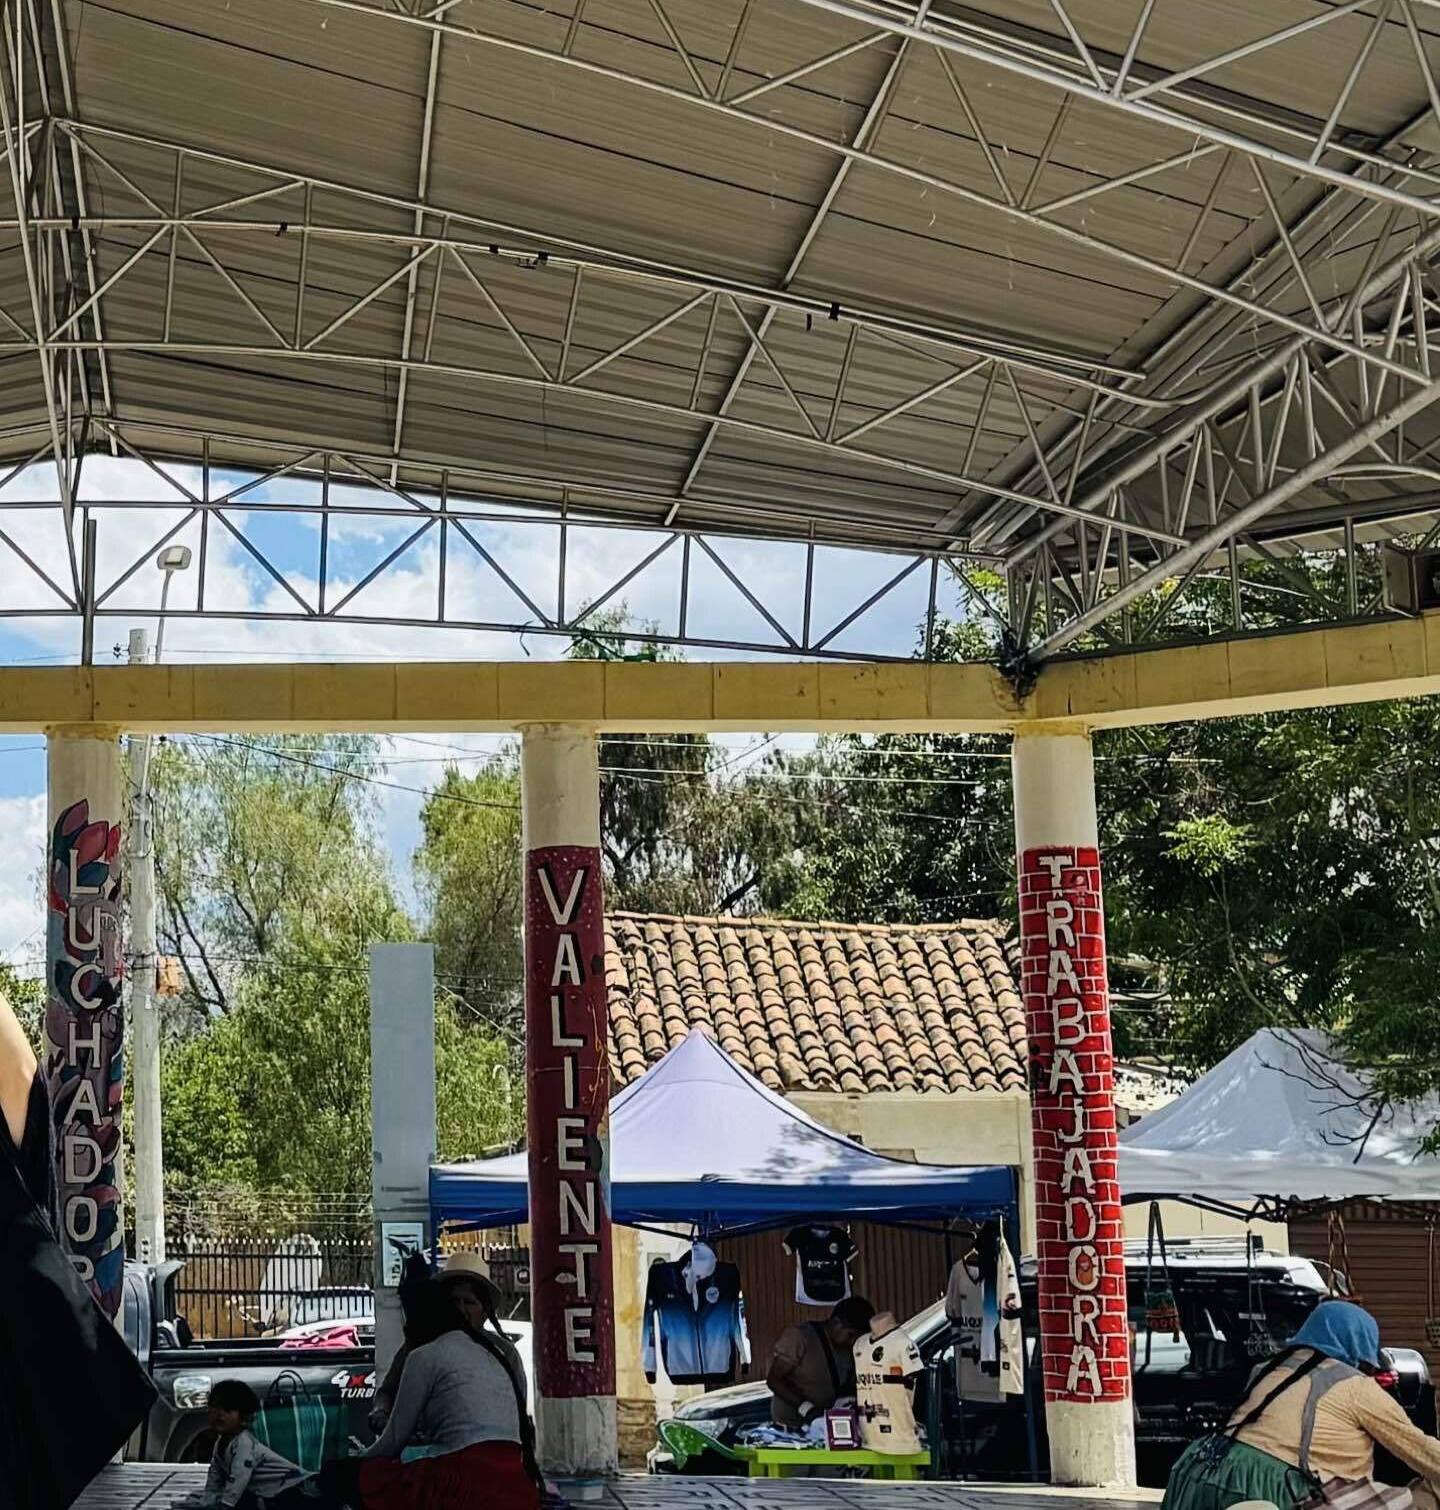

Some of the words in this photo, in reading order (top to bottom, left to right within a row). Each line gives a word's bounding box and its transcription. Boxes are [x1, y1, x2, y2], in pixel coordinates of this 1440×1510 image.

[537, 867, 597, 1364] VALIENTE
[1039, 856, 1102, 1395] TRABAJADORA
[341, 1388, 374, 1398] TURB
